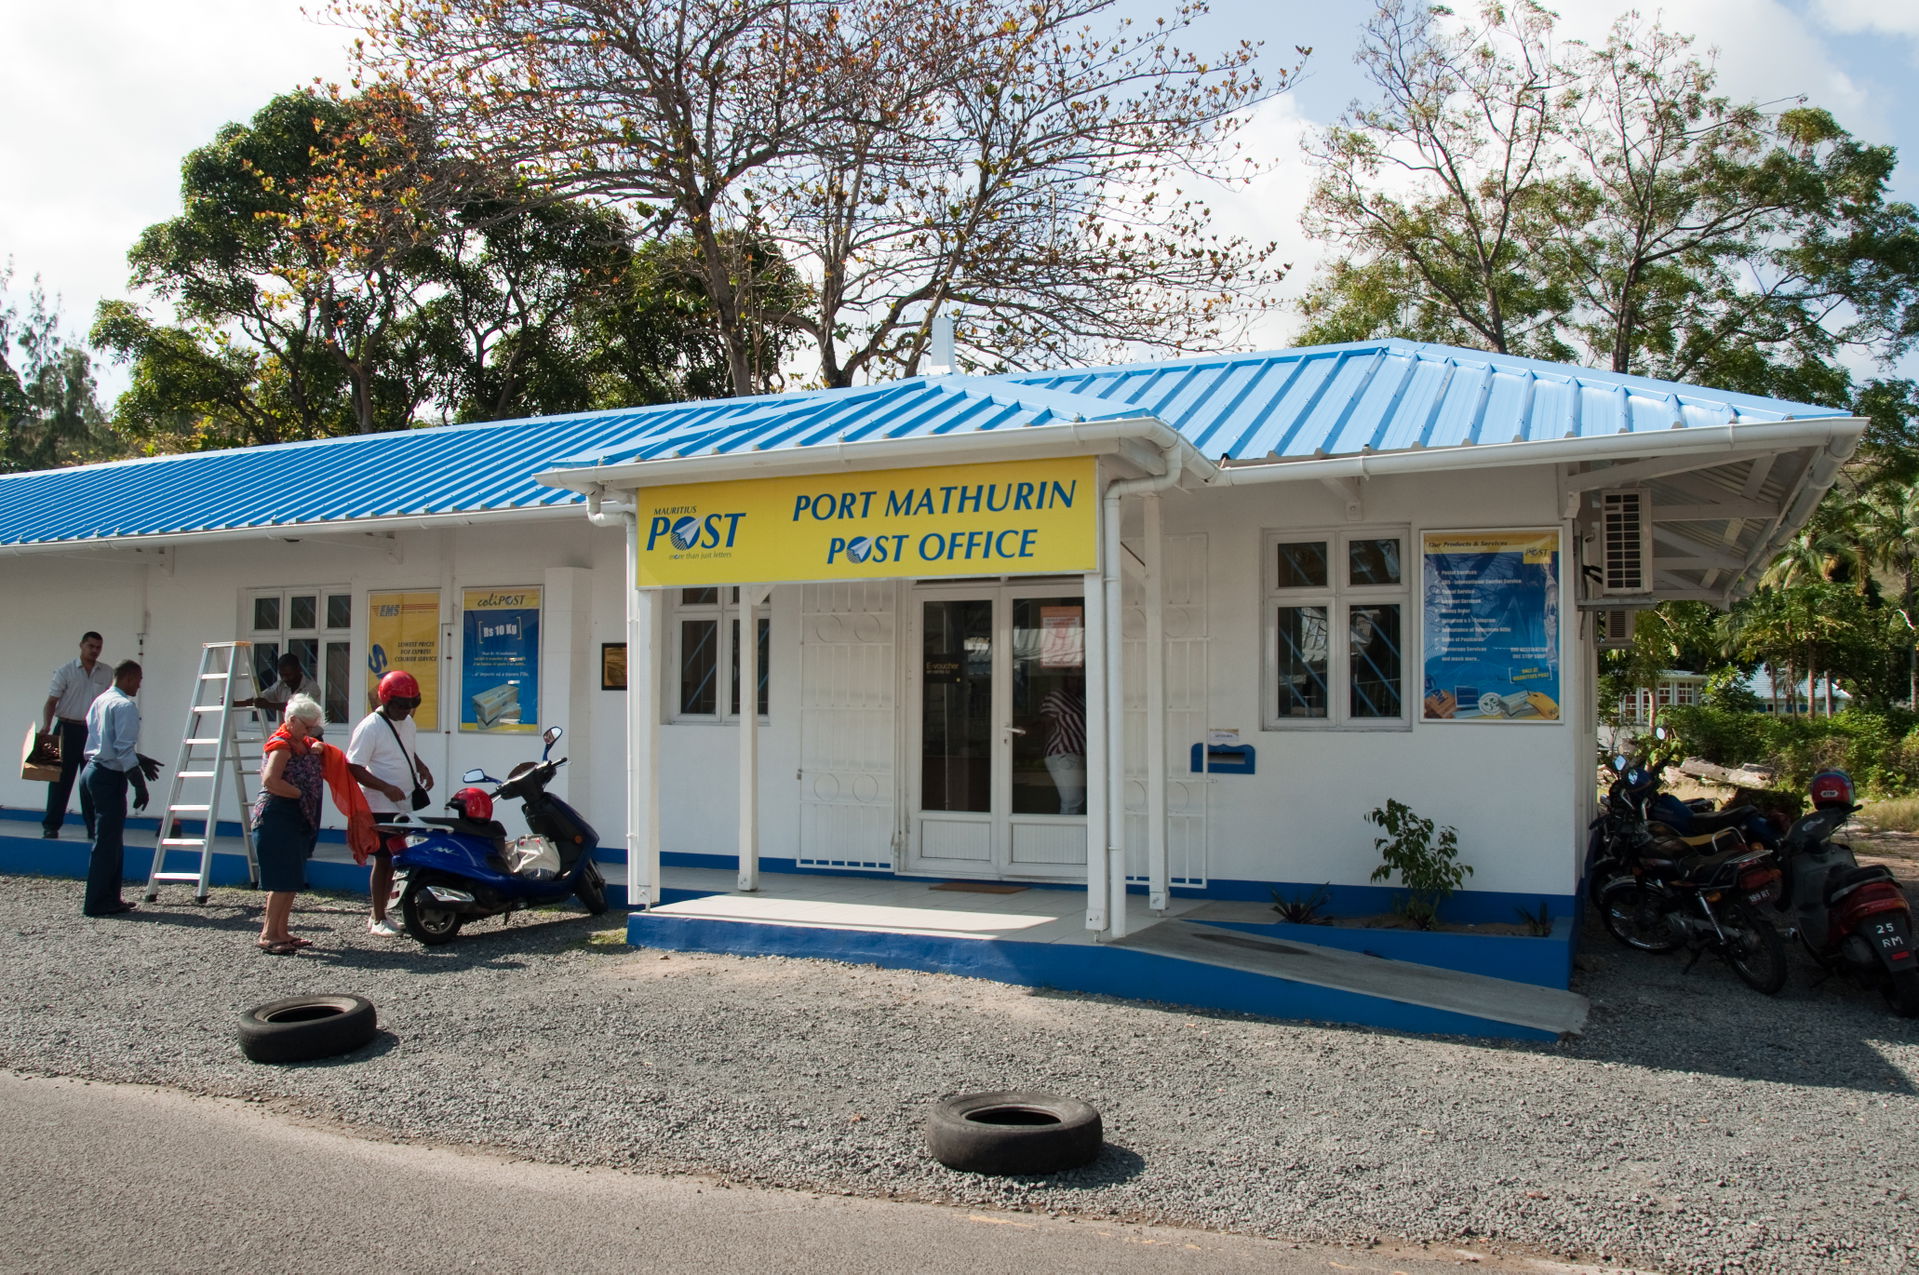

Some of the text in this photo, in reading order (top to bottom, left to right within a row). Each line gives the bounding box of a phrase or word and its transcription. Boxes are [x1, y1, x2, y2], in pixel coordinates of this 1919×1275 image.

[792, 479, 1077, 522] PORT MATHURIN
[653, 505, 697, 515] MAURITIUS
[646, 512, 747, 551] POST
[827, 528, 1038, 565] POST OFFICE
[700, 552, 712, 560] just
[379, 604, 401, 617] EMS
[495, 625, 504, 636] 10
[506, 624, 517, 635] Kg
[1876, 922, 1895, 934] 25
[1881, 935, 1904, 948] RM
